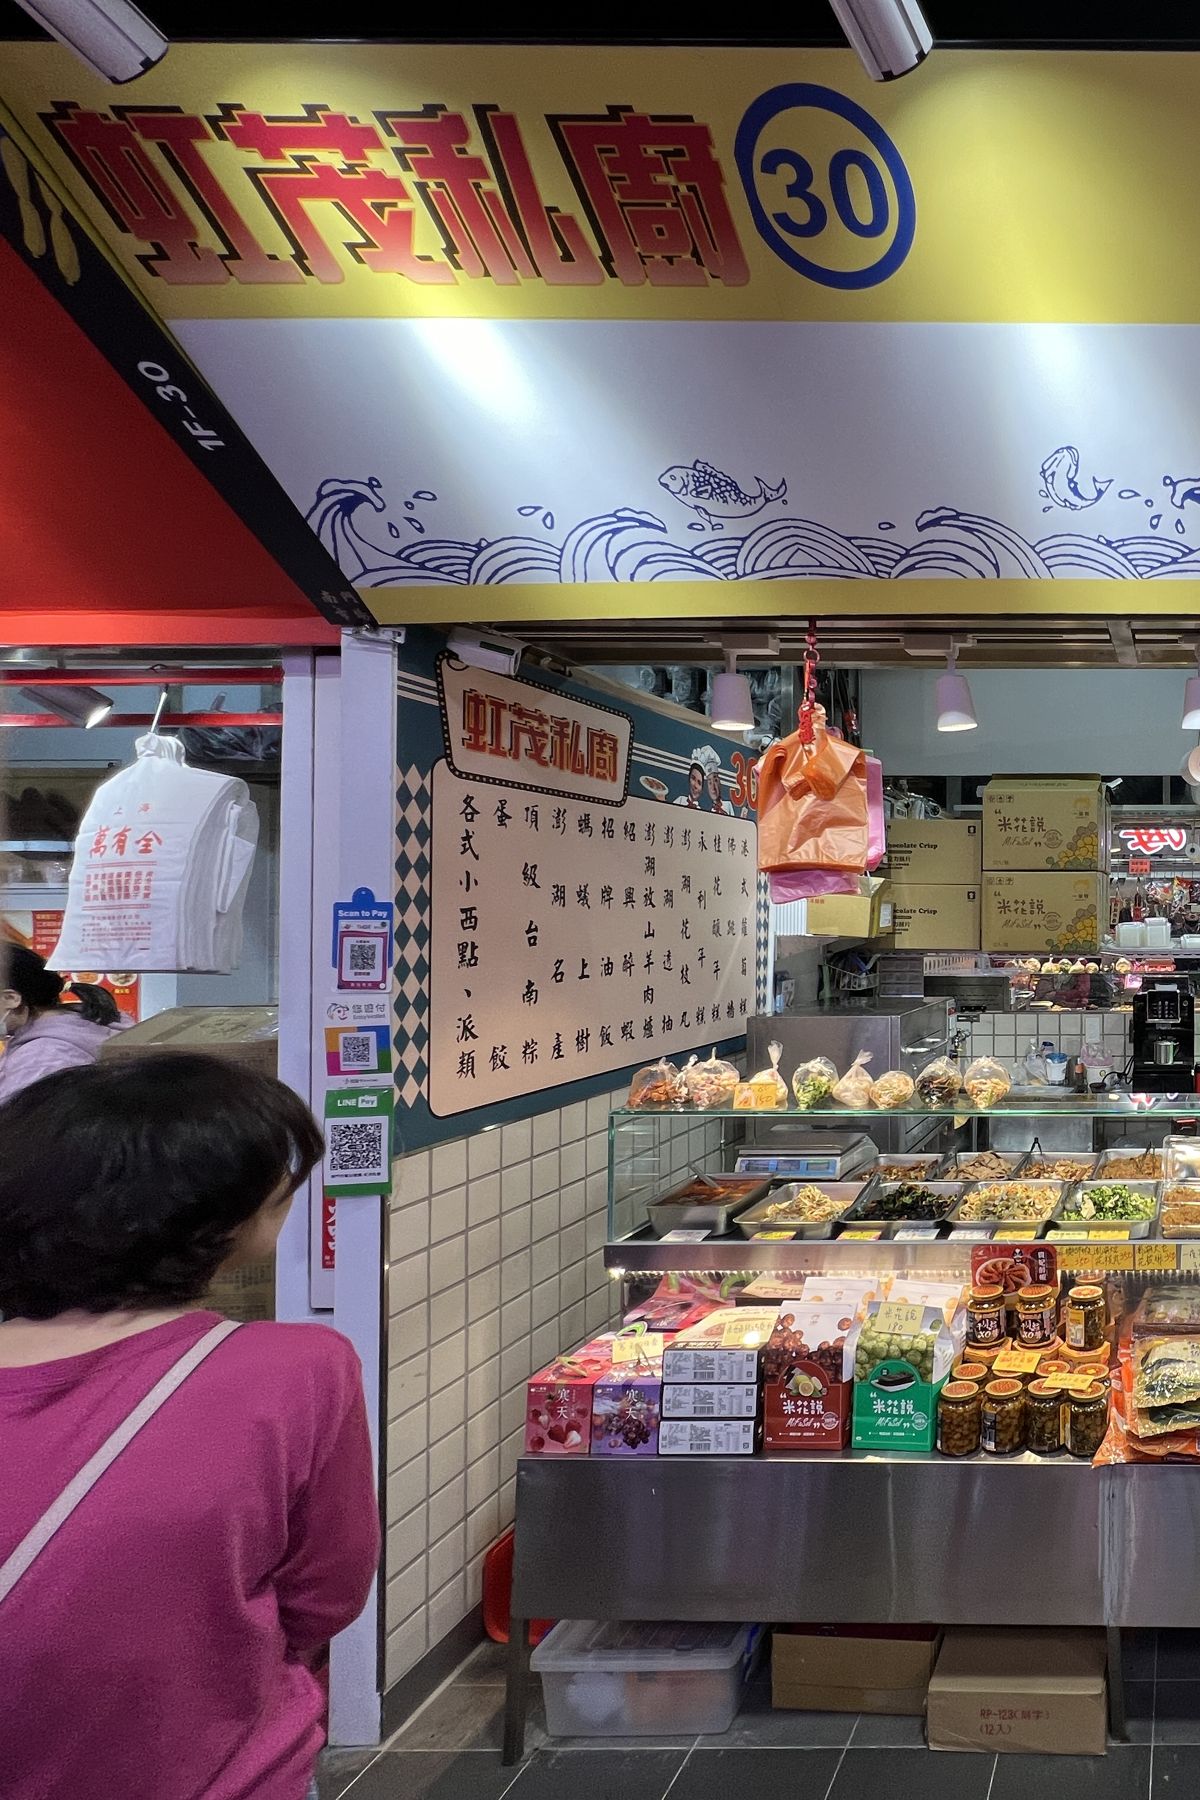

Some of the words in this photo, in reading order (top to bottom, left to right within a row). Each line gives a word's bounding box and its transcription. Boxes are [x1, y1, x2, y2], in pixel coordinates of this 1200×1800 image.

[42, 102, 751, 287] 虹茂私廚
[760, 148, 890, 239] 30
[137, 361, 226, 451] 1F-30
[462, 688, 618, 783] 虹茂私廚
[89, 825, 163, 858] 萬有全
[998, 816, 1046, 833] 米花說
[372, 910, 388, 918] Pay
[456, 794, 481, 1080] 各式小西點、派類
[489, 799, 512, 1072] 蛋餃
[522, 804, 541, 1065] 頂級台南粽
[551, 807, 567, 1061] 澎湖名產
[575, 812, 593, 1053] 螞蟻上樹
[599, 816, 615, 1048] 招牌油飯
[620, 820, 636, 1042] 紹興醉蝦
[997, 899, 1046, 915] 米花說
[337, 1098, 357, 1107] LINE
[557, 1388, 570, 1419] 寒天
[625, 1388, 639, 1420] 寒天
[782, 1399, 824, 1415] 米花說
[873, 1399, 915, 1415] 米花說
